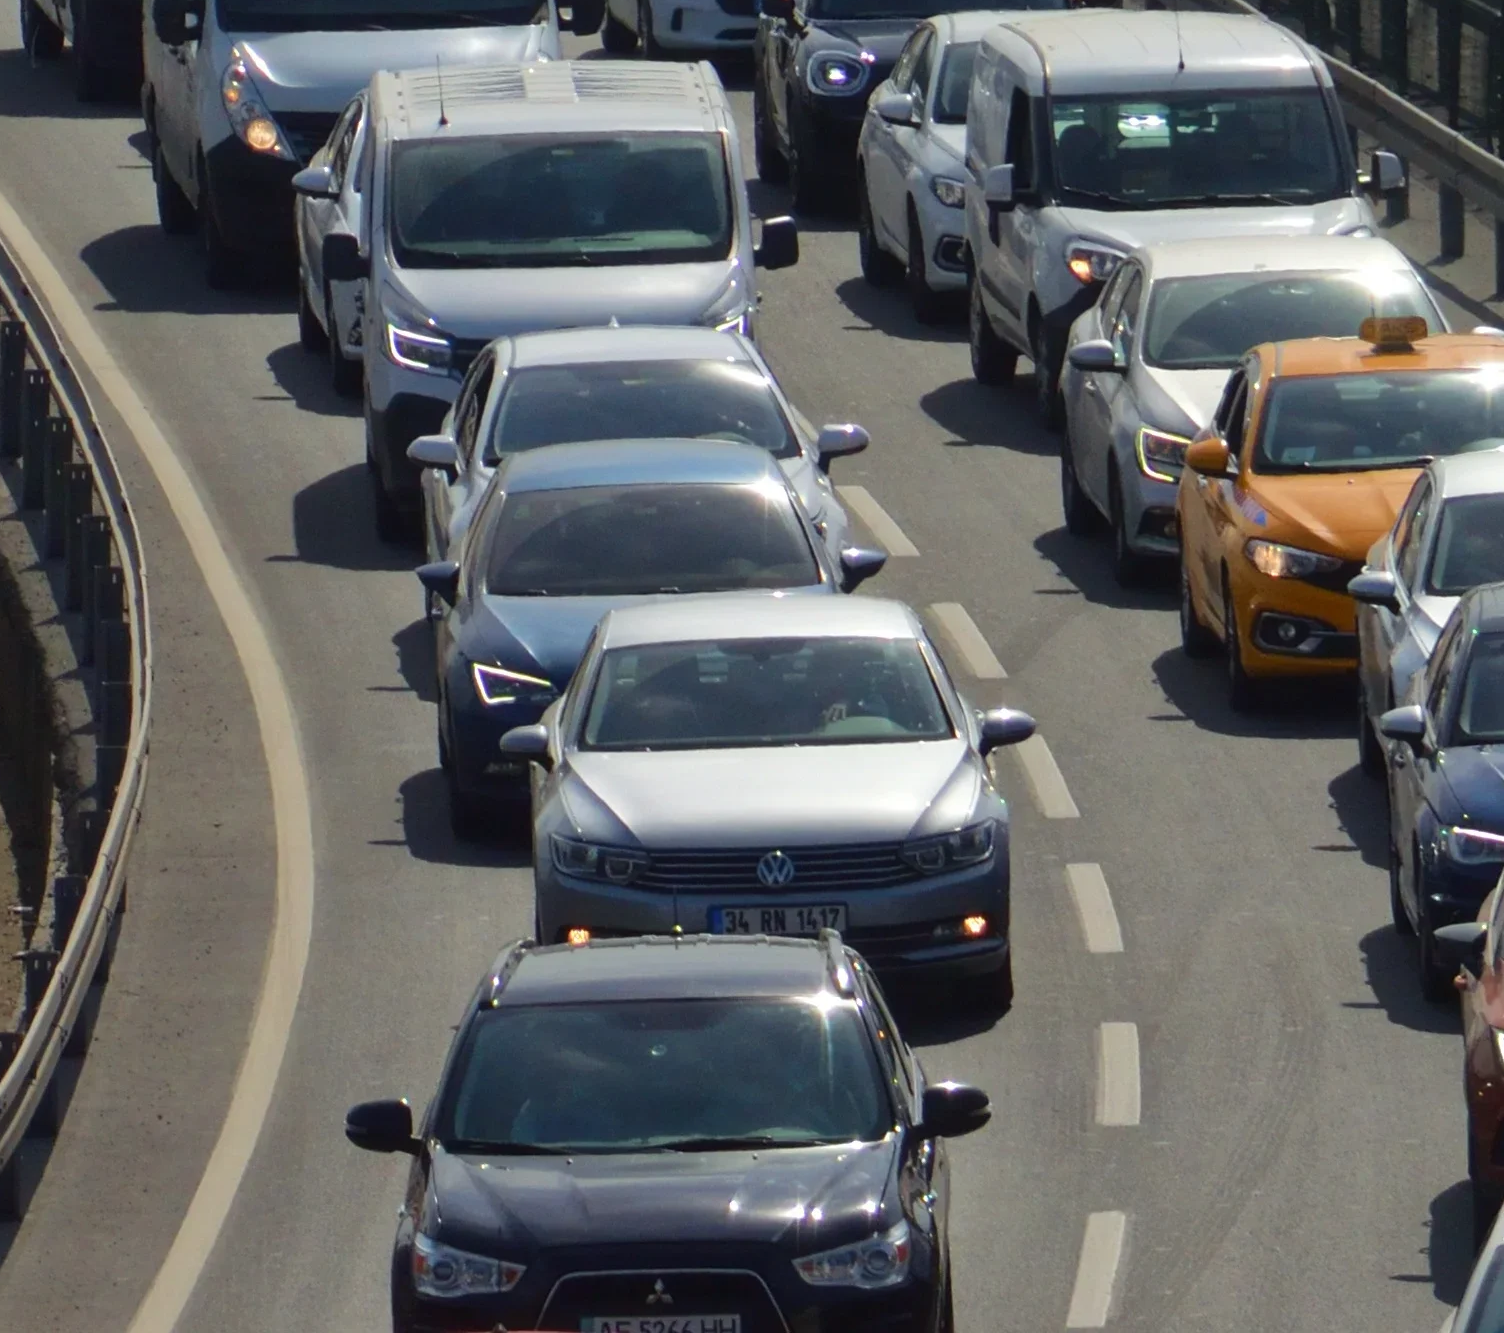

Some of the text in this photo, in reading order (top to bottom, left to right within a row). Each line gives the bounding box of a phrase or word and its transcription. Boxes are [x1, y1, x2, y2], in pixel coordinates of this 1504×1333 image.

[724, 908, 840, 933] 34 RN 1417
